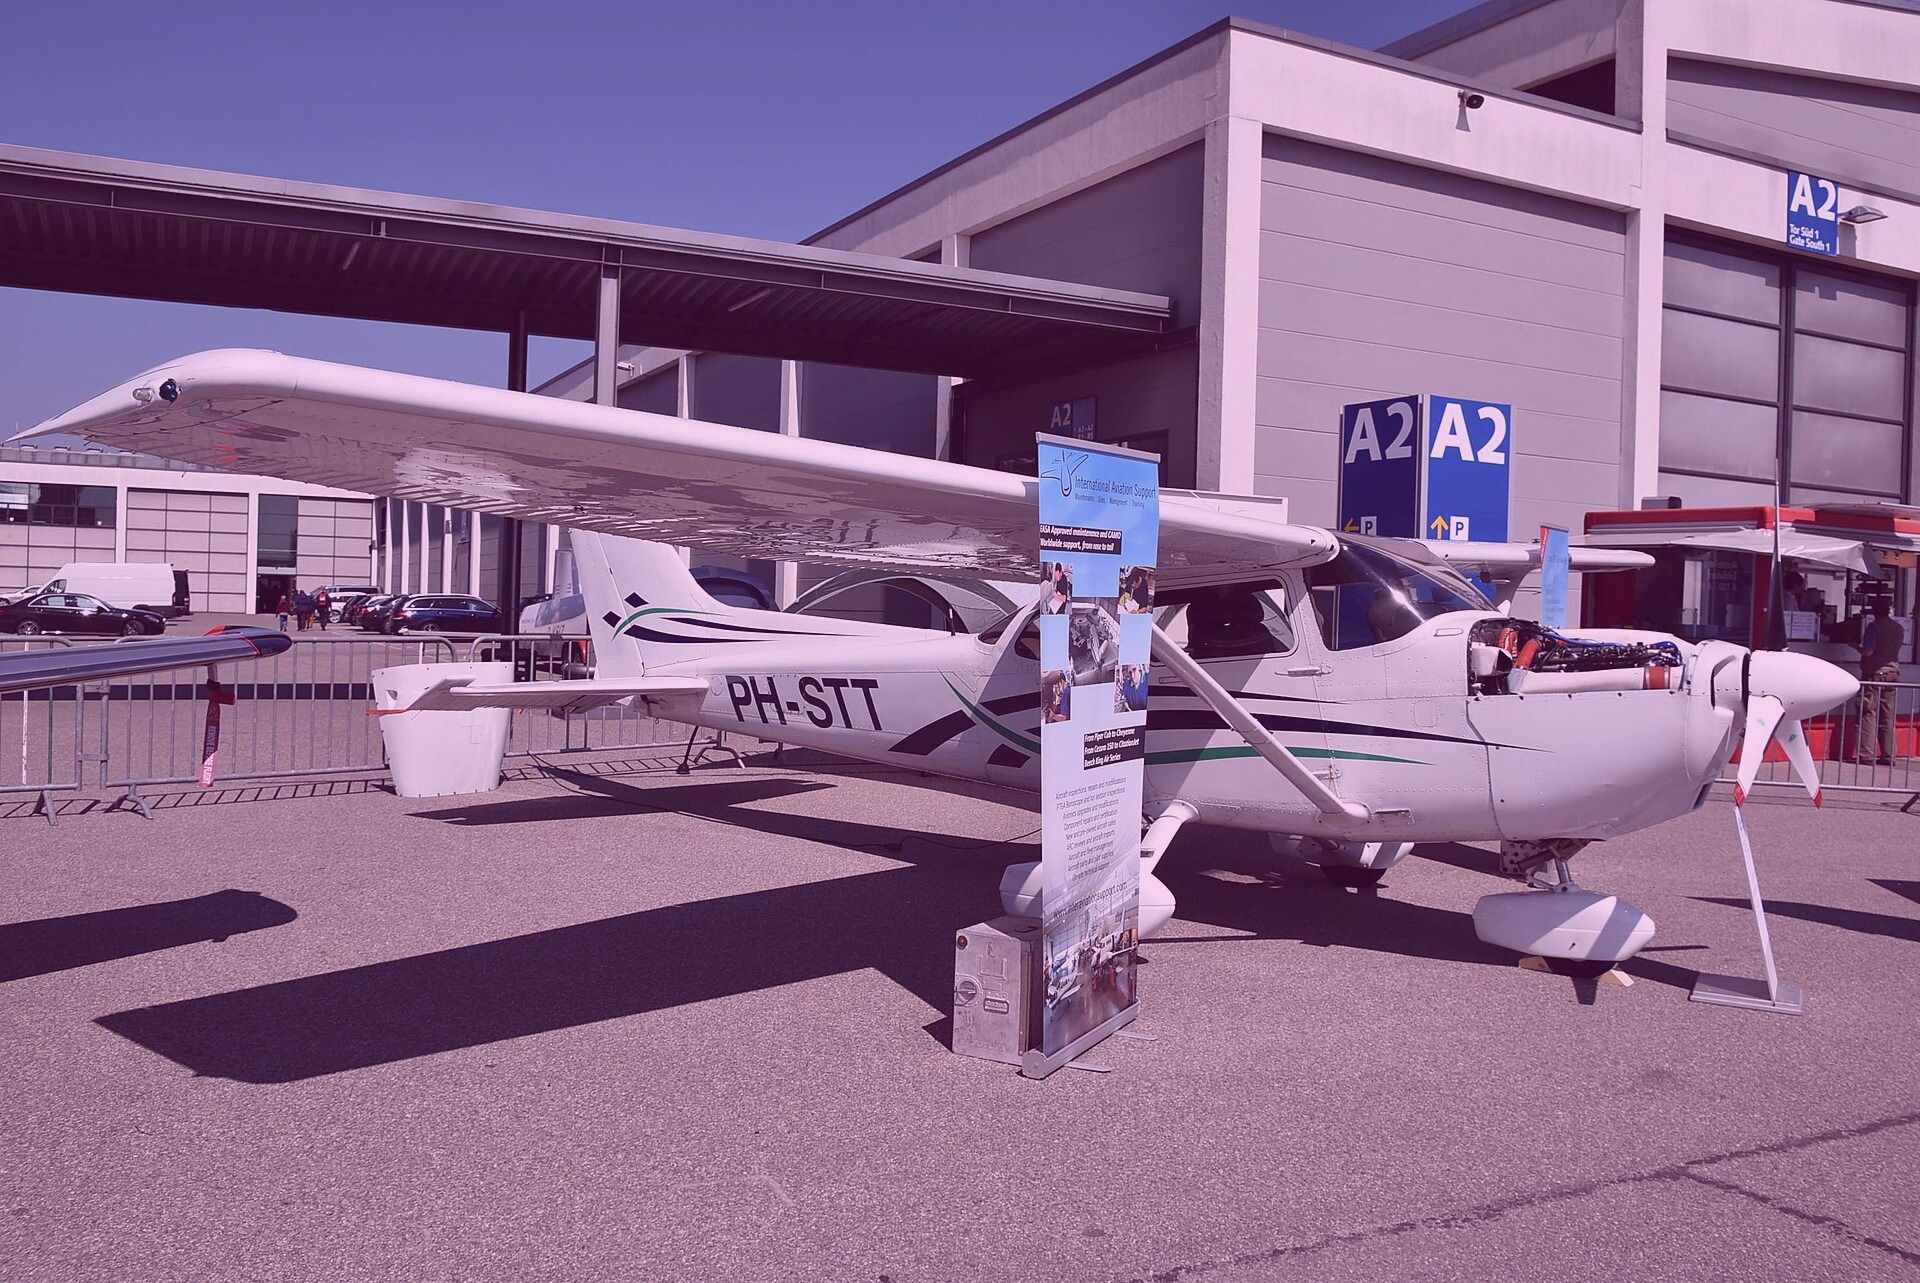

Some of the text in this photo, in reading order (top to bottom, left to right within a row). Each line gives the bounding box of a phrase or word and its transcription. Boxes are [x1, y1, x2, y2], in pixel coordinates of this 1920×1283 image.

[1790, 174, 1837, 221] A2
[1790, 224, 1819, 239] Tor Süd 1
[1790, 235, 1830, 252] Gate South 1
[1050, 403, 1071, 428] A2
[1344, 401, 1414, 464] A2
[1430, 402, 1507, 465] A2
[1075, 476, 1156, 499] International Aviation Support
[1040, 525, 1050, 533] EASA
[1051, 526, 1072, 536] Approved
[1073, 528, 1099, 537] maintenance
[1108, 531, 1121, 539] CAMO
[1365, 520, 1373, 535] P
[1456, 522, 1464, 536] P
[1040, 538, 1062, 547] Worldwide
[1063, 540, 1081, 550] support,
[1081, 541, 1092, 551] from
[1107, 543, 1115, 551] tail
[725, 675, 882, 731] PH-STT
[1095, 732, 1104, 741] Piper
[1116, 728, 1135, 737] Cheyenne
[1094, 745, 1106, 753] Cessna
[1084, 758, 1095, 767] Beech
[1110, 753, 1121, 761] Series
[1055, 790, 1068, 800] Aircraft
[1105, 777, 1126, 786] modifications
[1063, 811, 1076, 819] Avionics
[1064, 819, 1082, 830] Component
[1069, 851, 1080, 860] Aircraft
[1068, 862, 1079, 871] Aircraft
